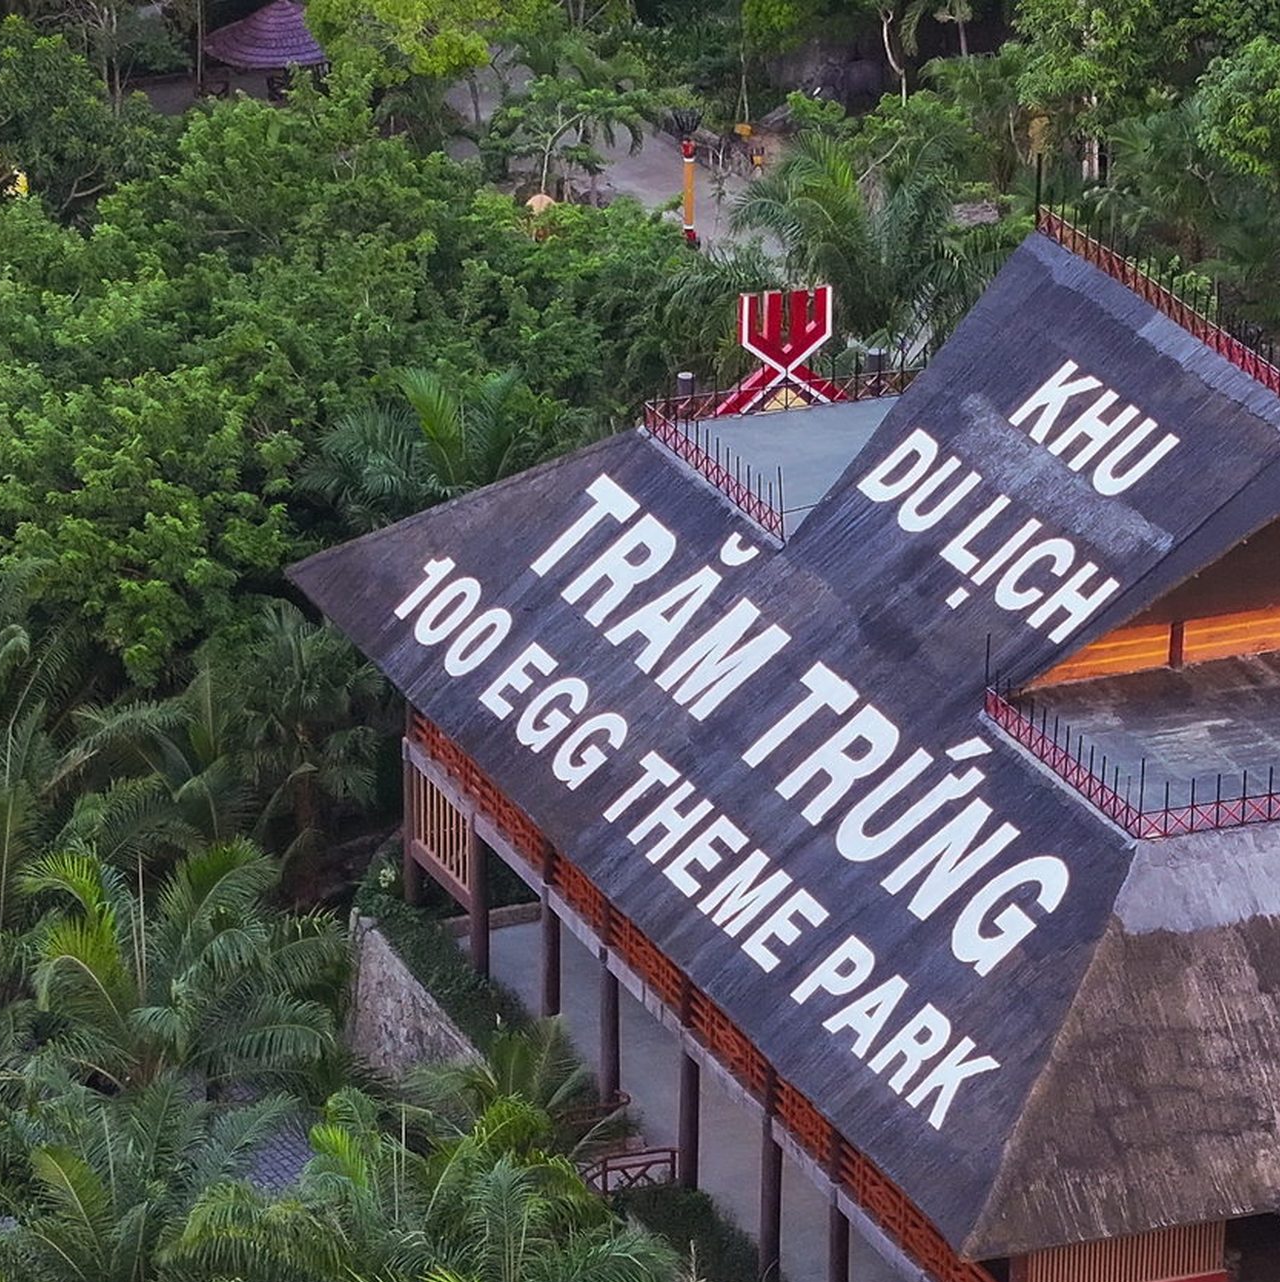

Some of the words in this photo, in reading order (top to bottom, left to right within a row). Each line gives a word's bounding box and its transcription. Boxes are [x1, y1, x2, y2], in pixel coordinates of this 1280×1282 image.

[856, 428, 983, 533] DU
[939, 493, 1120, 644] LỊCH
[1008, 359, 1180, 496] KHU
[394, 556, 514, 677] 100
[478, 641, 629, 794] EGG
[602, 750, 830, 973] THEME
[790, 934, 1001, 1131] PARK
[529, 472, 792, 722] TRĂM
[741, 660, 1070, 977] TRỨNG
